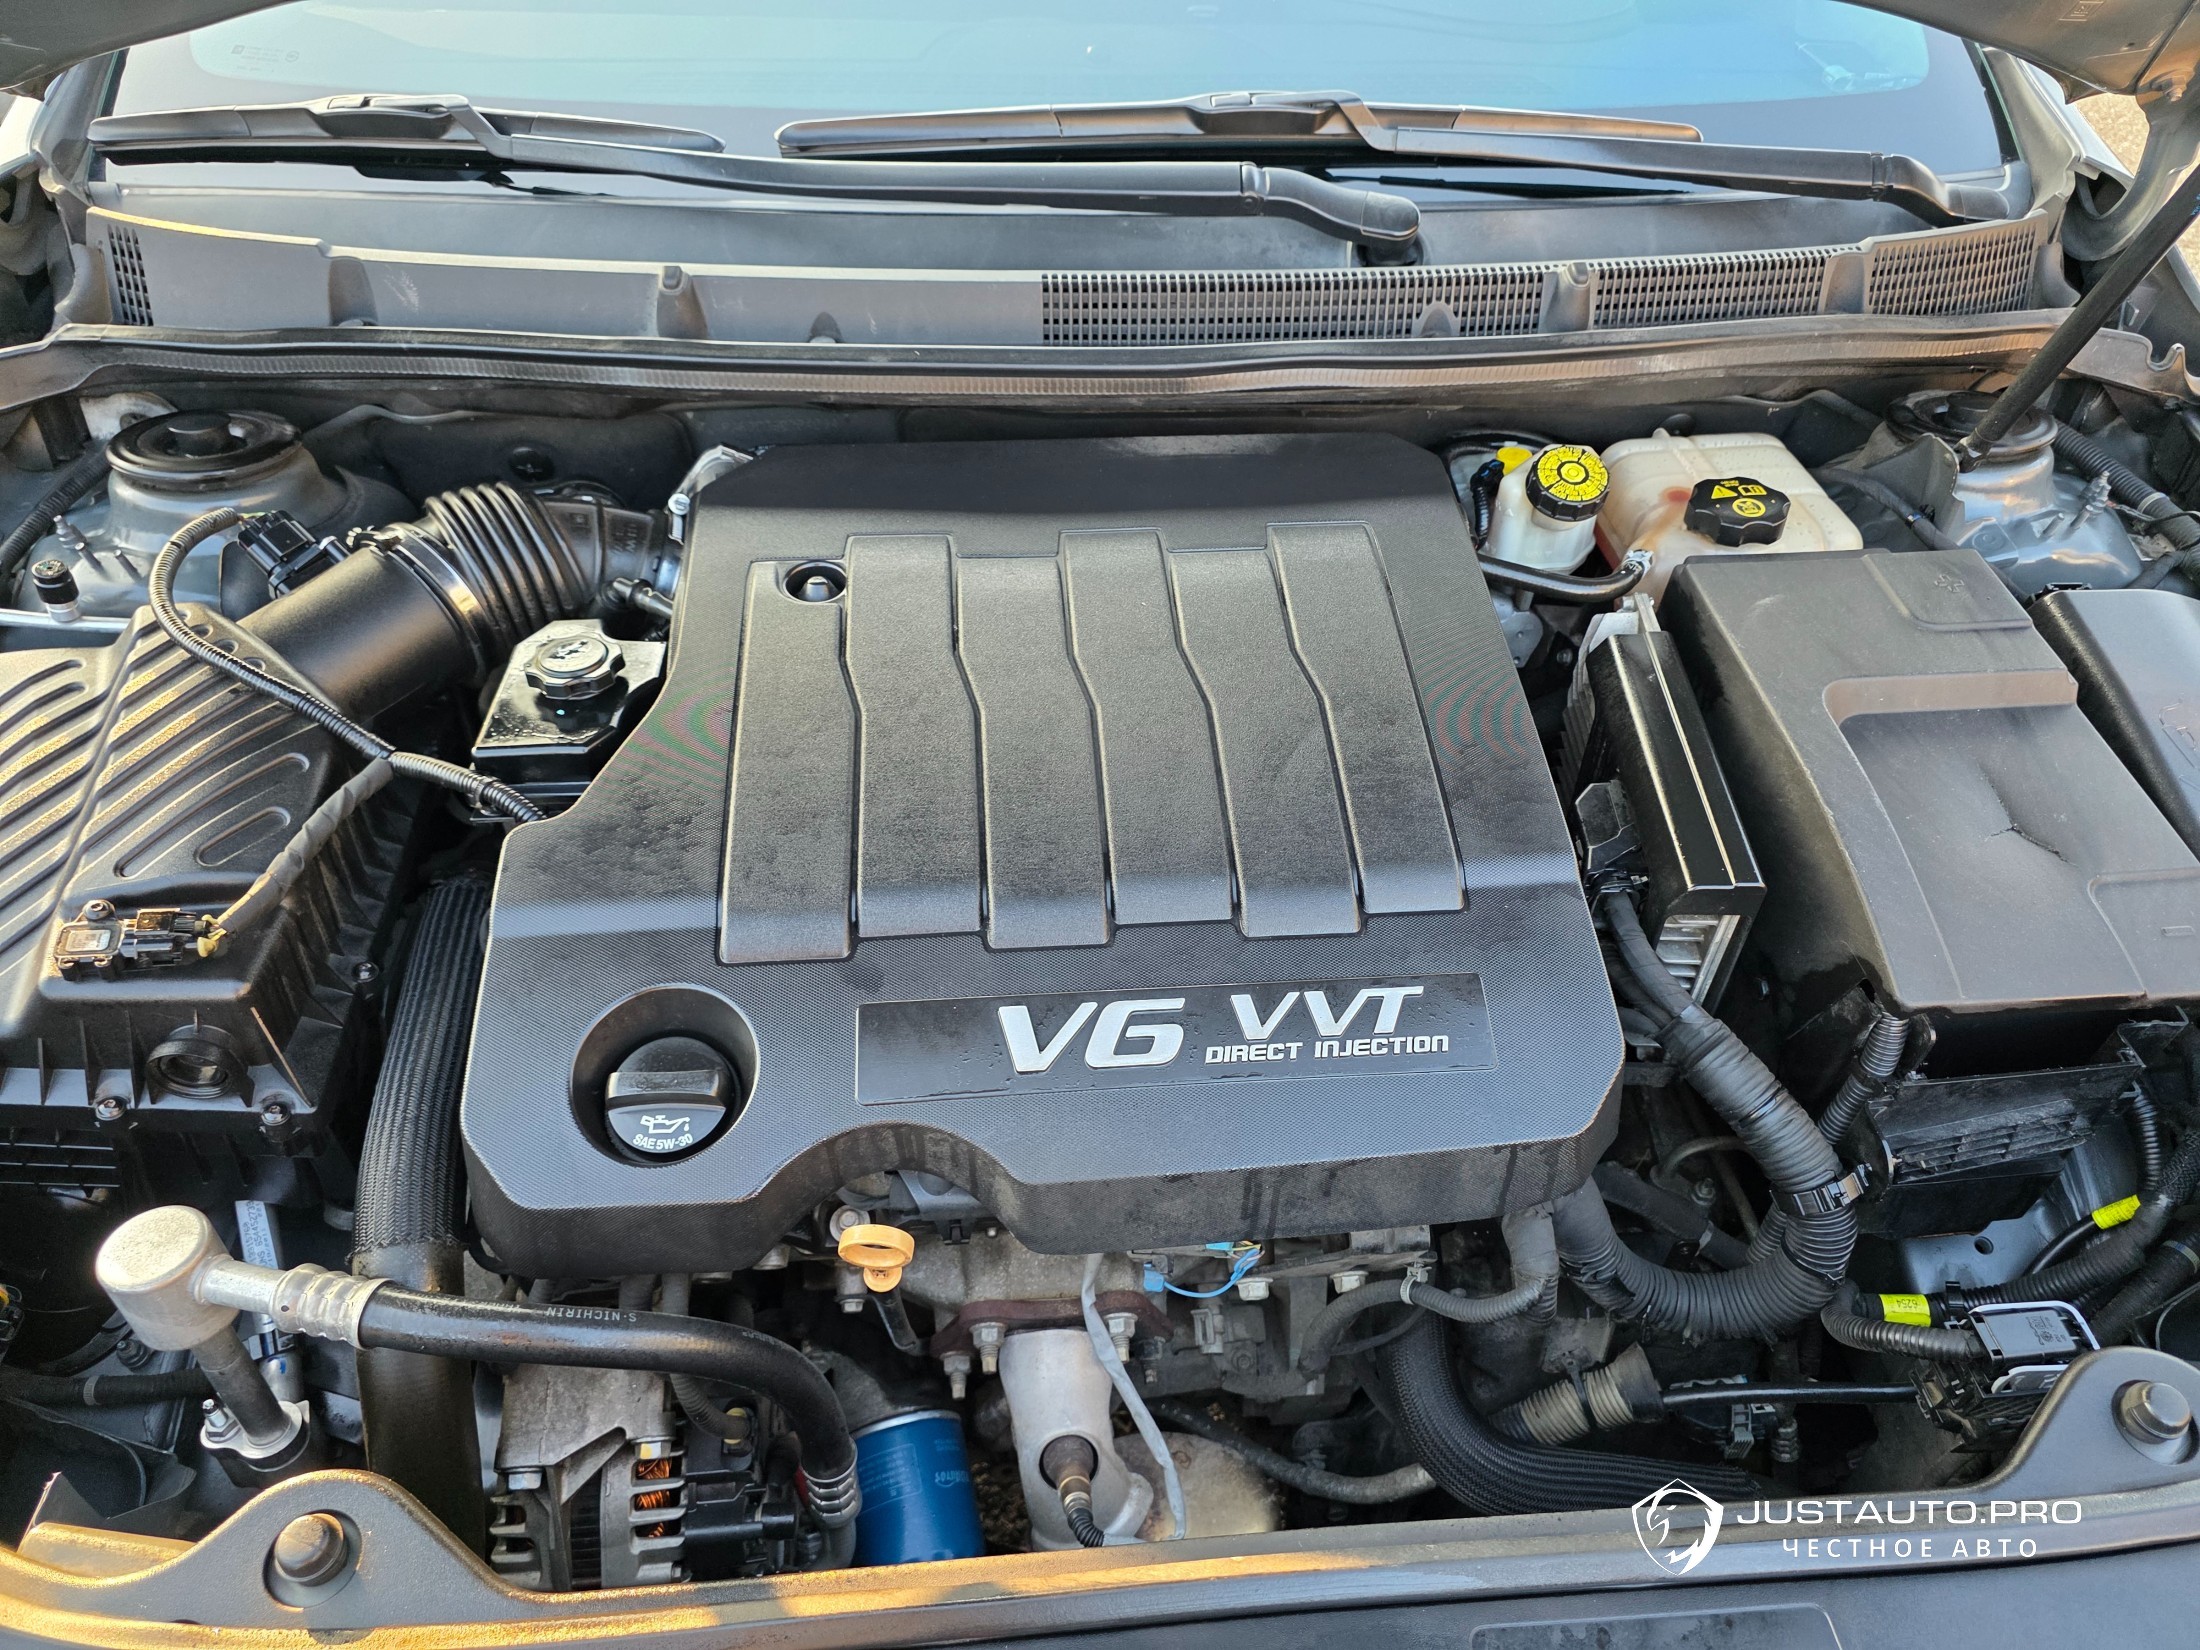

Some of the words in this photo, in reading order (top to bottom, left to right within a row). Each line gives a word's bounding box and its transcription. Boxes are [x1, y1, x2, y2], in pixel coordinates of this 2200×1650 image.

[999, 997, 1186, 1073] V6
[1230, 985, 1425, 1041] VVT
[1205, 1041, 1303, 1065] DIRECT
[1314, 1034, 1449, 1060] INJECTION
[632, 1133, 656, 1150] SAE
[655, 1133, 694, 1150] 5W-30
